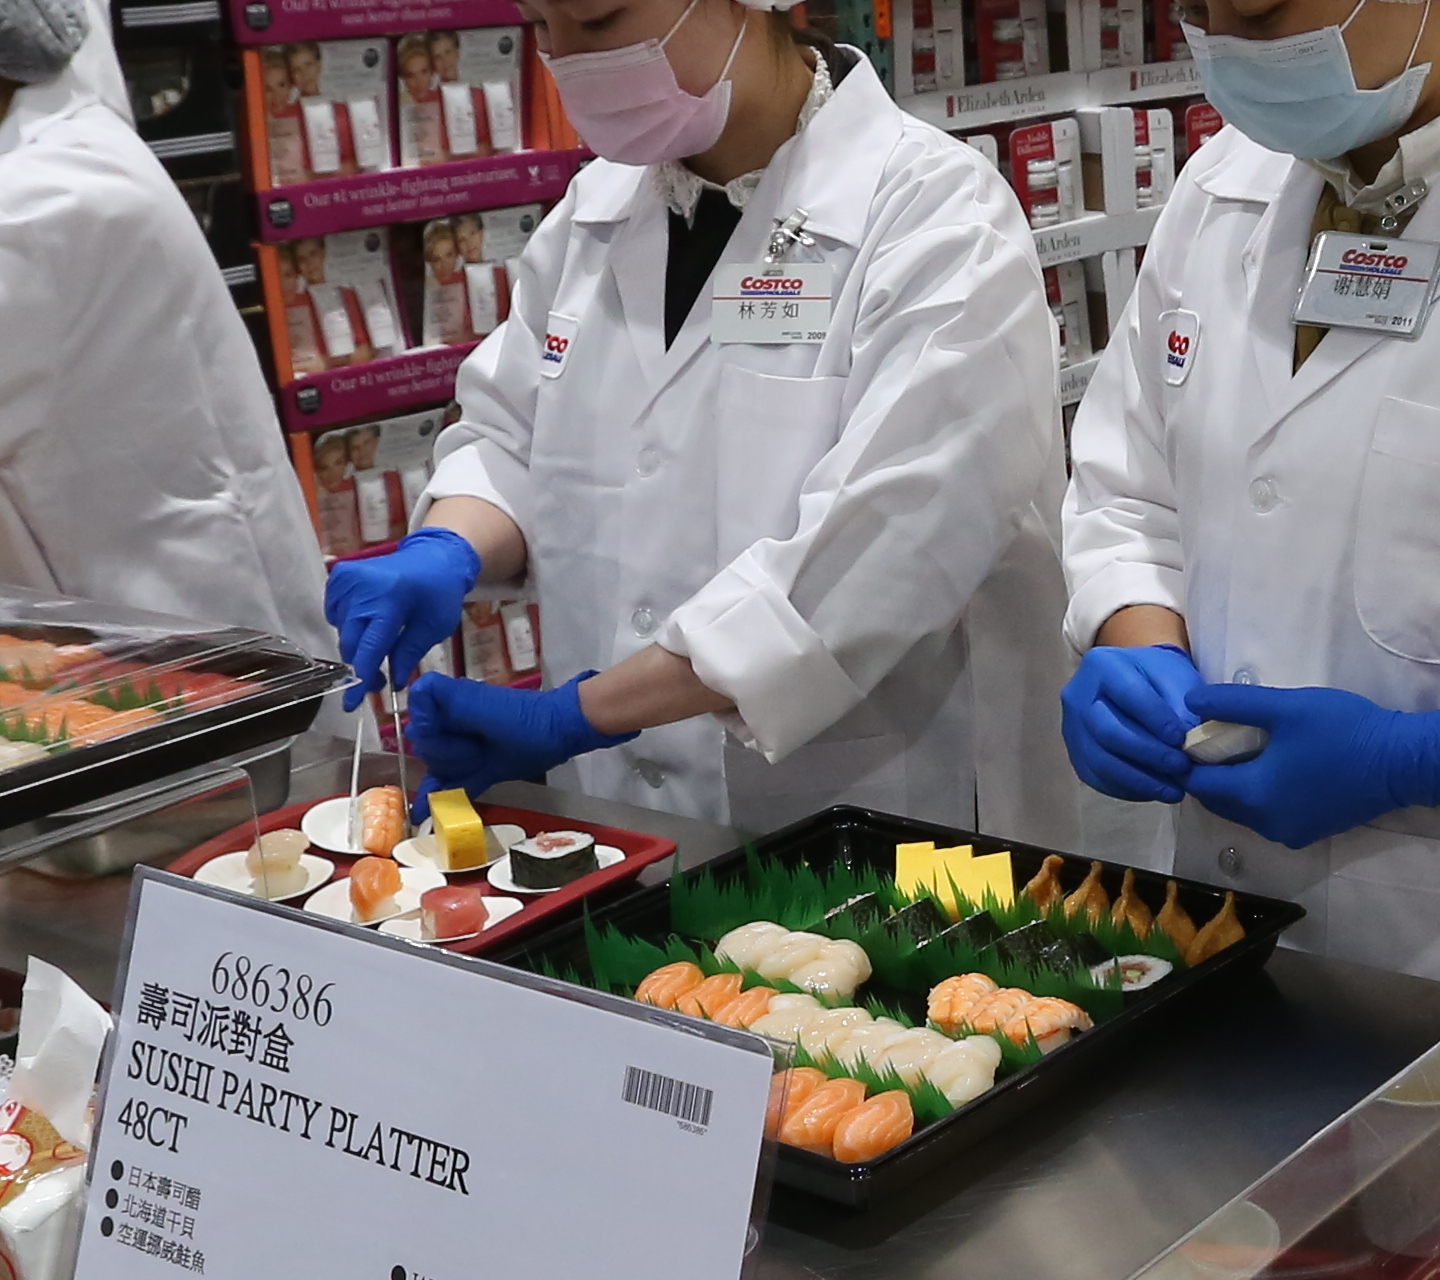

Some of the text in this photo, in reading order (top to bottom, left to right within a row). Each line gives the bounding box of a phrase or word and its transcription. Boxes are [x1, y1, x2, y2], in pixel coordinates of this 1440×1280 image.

[957, 86, 1046, 114] Elizabeth Arden
[1050, 232, 1082, 252] Arden
[1340, 248, 1409, 269] COSTCO
[739, 276, 804, 290] COSTCO
[738, 301, 800, 320] 林芳如
[1060, 372, 1089, 394] rden
[210, 950, 337, 1029] 686386
[135, 980, 297, 1075] 壽司派對盒
[116, 1096, 189, 1155] 48CT
[125, 1039, 471, 1197] SUSHI PARTY PLATTER
[121, 1193, 196, 1241] 北海道干貝
